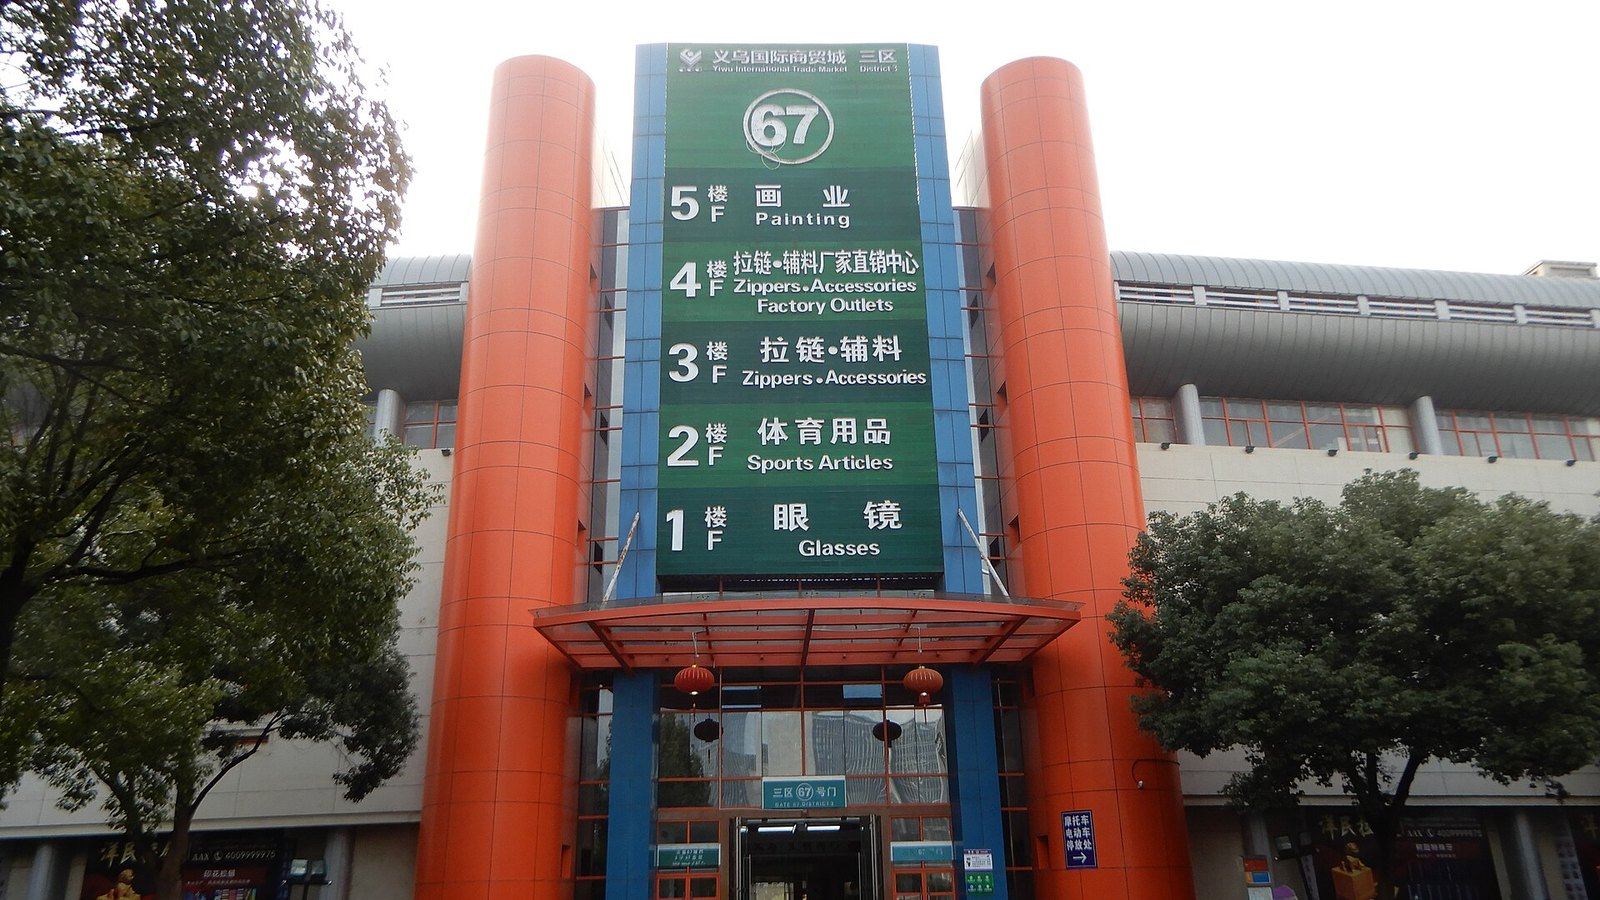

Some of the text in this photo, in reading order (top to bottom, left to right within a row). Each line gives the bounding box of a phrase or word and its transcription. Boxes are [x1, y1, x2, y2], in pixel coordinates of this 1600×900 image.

[712, 49, 897, 64] 义乌国际商贸城 三区
[750, 103, 819, 148] 67
[670, 185, 700, 221] 5
[707, 184, 728, 203] 楼
[755, 184, 850, 209] 画业
[711, 206, 725, 223] F
[755, 212, 850, 229] Painting
[669, 261, 701, 298] 4
[706, 260, 728, 279] 楼
[709, 279, 724, 297] F
[757, 297, 894, 315] Factory Outlets
[706, 341, 728, 361] 楼
[668, 342, 699, 383] 3
[712, 365, 728, 384] F
[705, 423, 728, 444] 楼
[757, 416, 891, 446] 体育用品
[667, 424, 700, 467] 2
[708, 446, 724, 466] F
[747, 454, 893, 474] Sports Articles
[704, 505, 728, 528] 楼
[772, 500, 903, 532] 眼镜
[665, 508, 685, 551] 1
[707, 530, 723, 551] F
[798, 539, 881, 557] Glasses
[772, 786, 837, 798] 三区 67 号门
[1064, 814, 1090, 827] 摩托车
[1065, 827, 1091, 839] 电动车
[1066, 838, 1092, 851] 停放处
